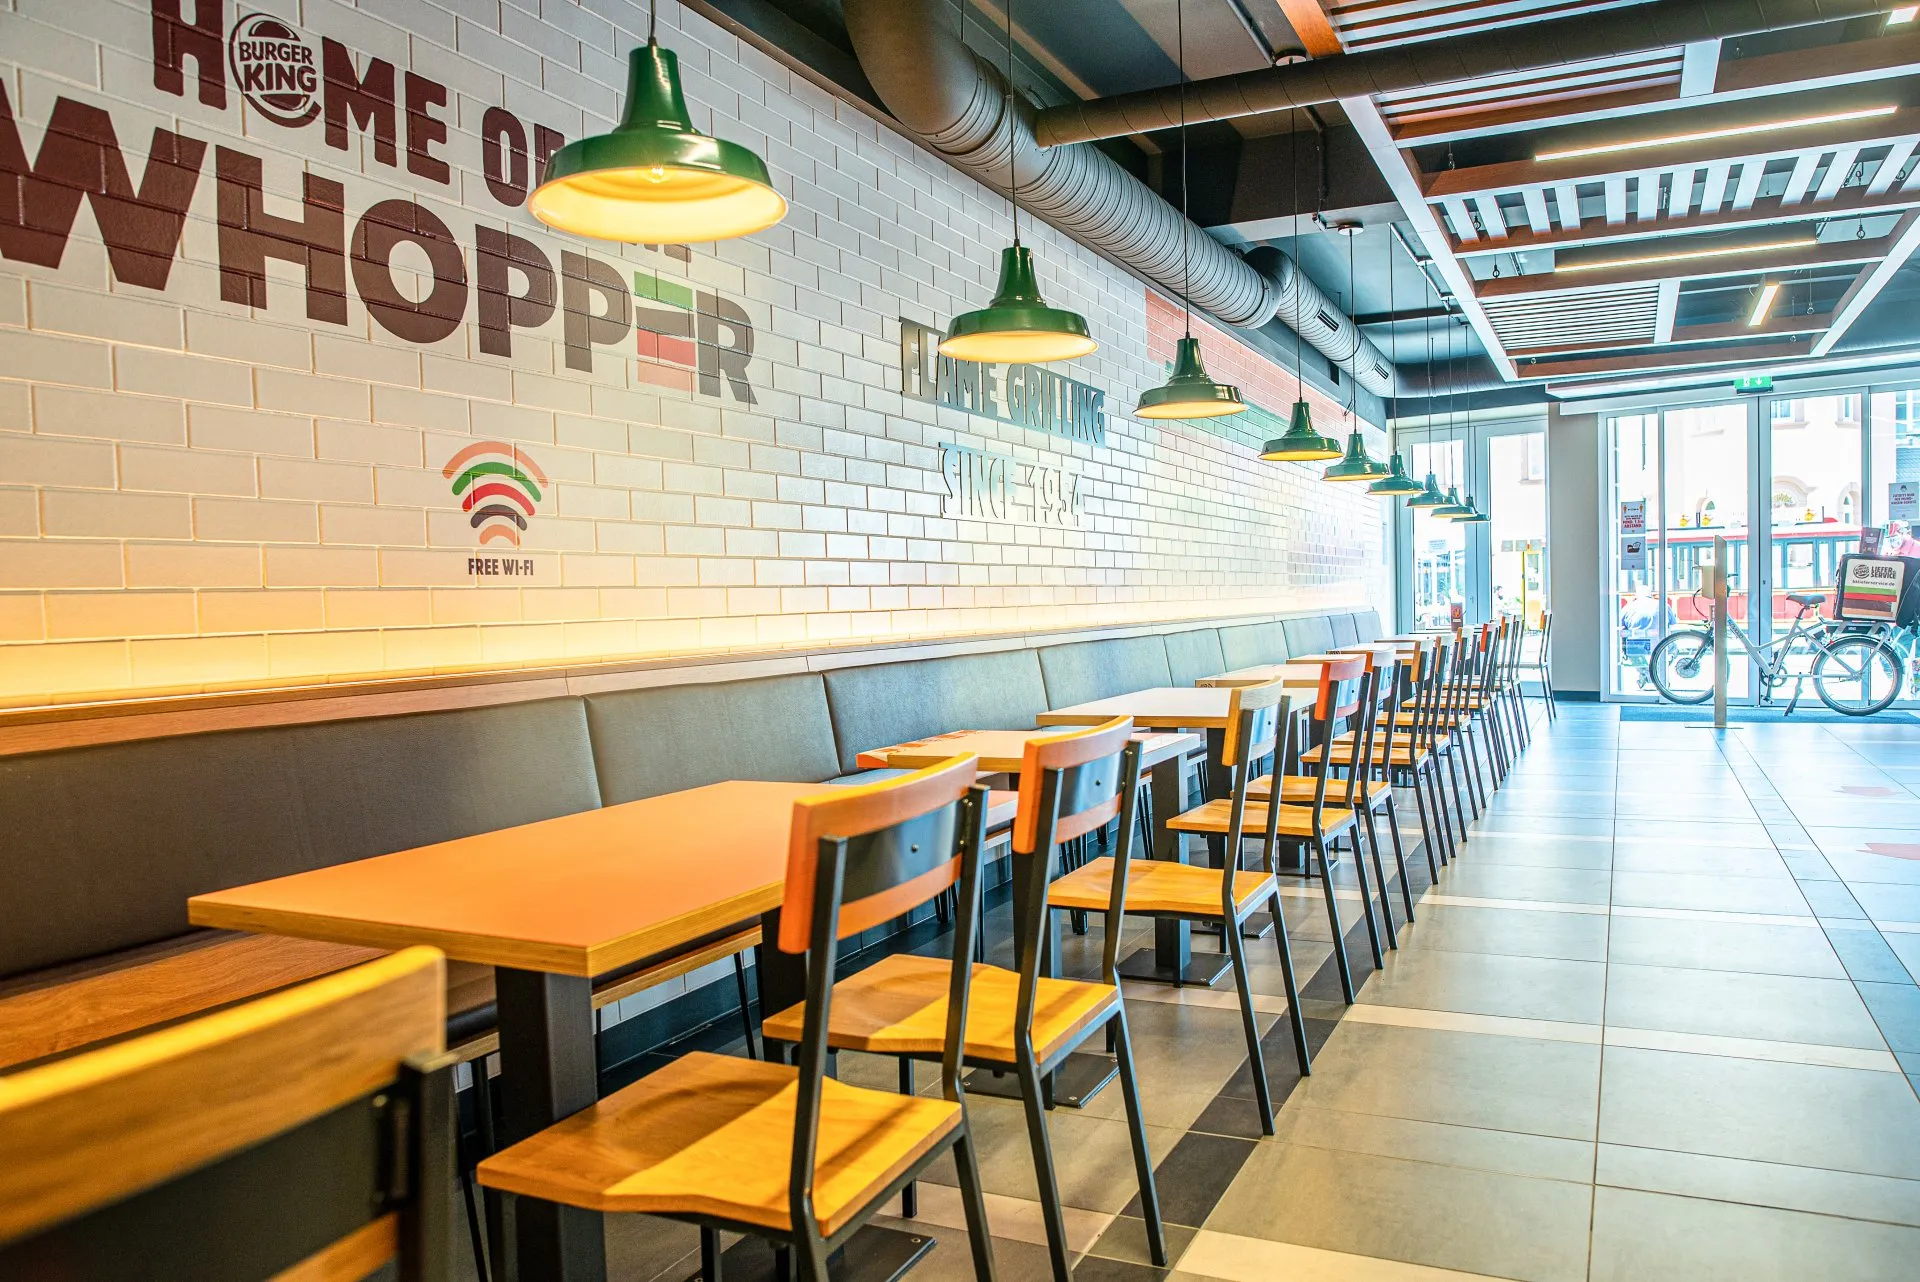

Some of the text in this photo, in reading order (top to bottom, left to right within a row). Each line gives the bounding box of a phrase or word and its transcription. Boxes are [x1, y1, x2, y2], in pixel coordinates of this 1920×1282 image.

[239, 41, 314, 66] BURGER
[243, 62, 317, 93] KING
[0, 75, 758, 405] WHOPPER
[900, 316, 1105, 448] FLAME GRILLING
[938, 442, 1018, 522] SINCE
[468, 558, 534, 576] FREE WI-FI
[1870, 571, 1896, 579] SERVICE
